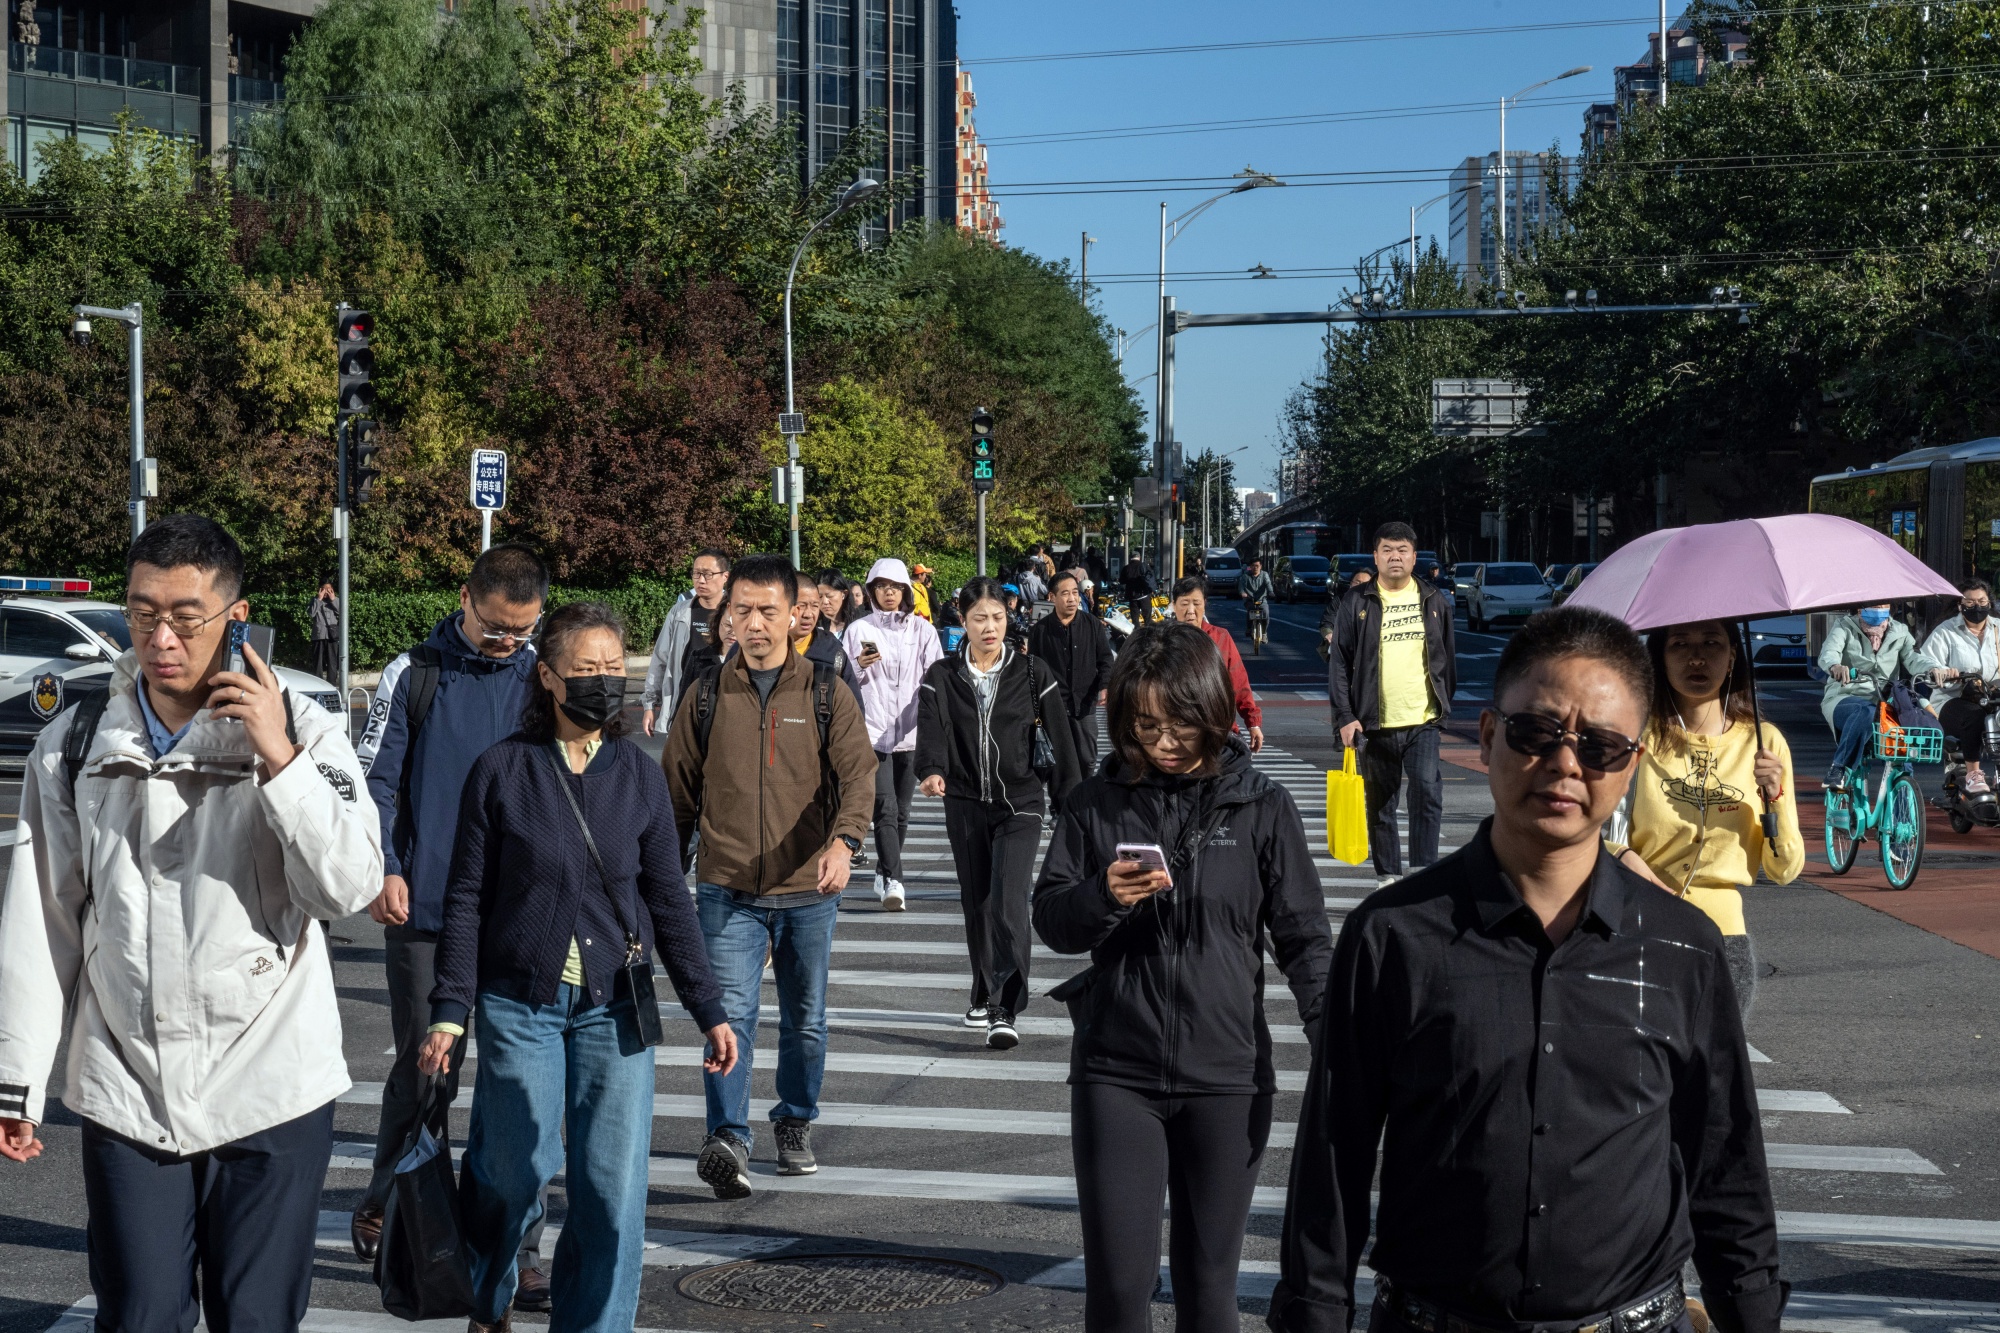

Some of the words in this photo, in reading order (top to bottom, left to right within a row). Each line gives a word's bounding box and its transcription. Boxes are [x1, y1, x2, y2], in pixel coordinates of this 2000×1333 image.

[1487, 164, 1511, 176] AIA
[480, 466, 498, 479] 公交车
[974, 460, 992, 479] 26
[476, 479, 502, 493] 专用车道
[1382, 616, 1422, 629] Dickies
[1381, 631, 1426, 642] Dickies
